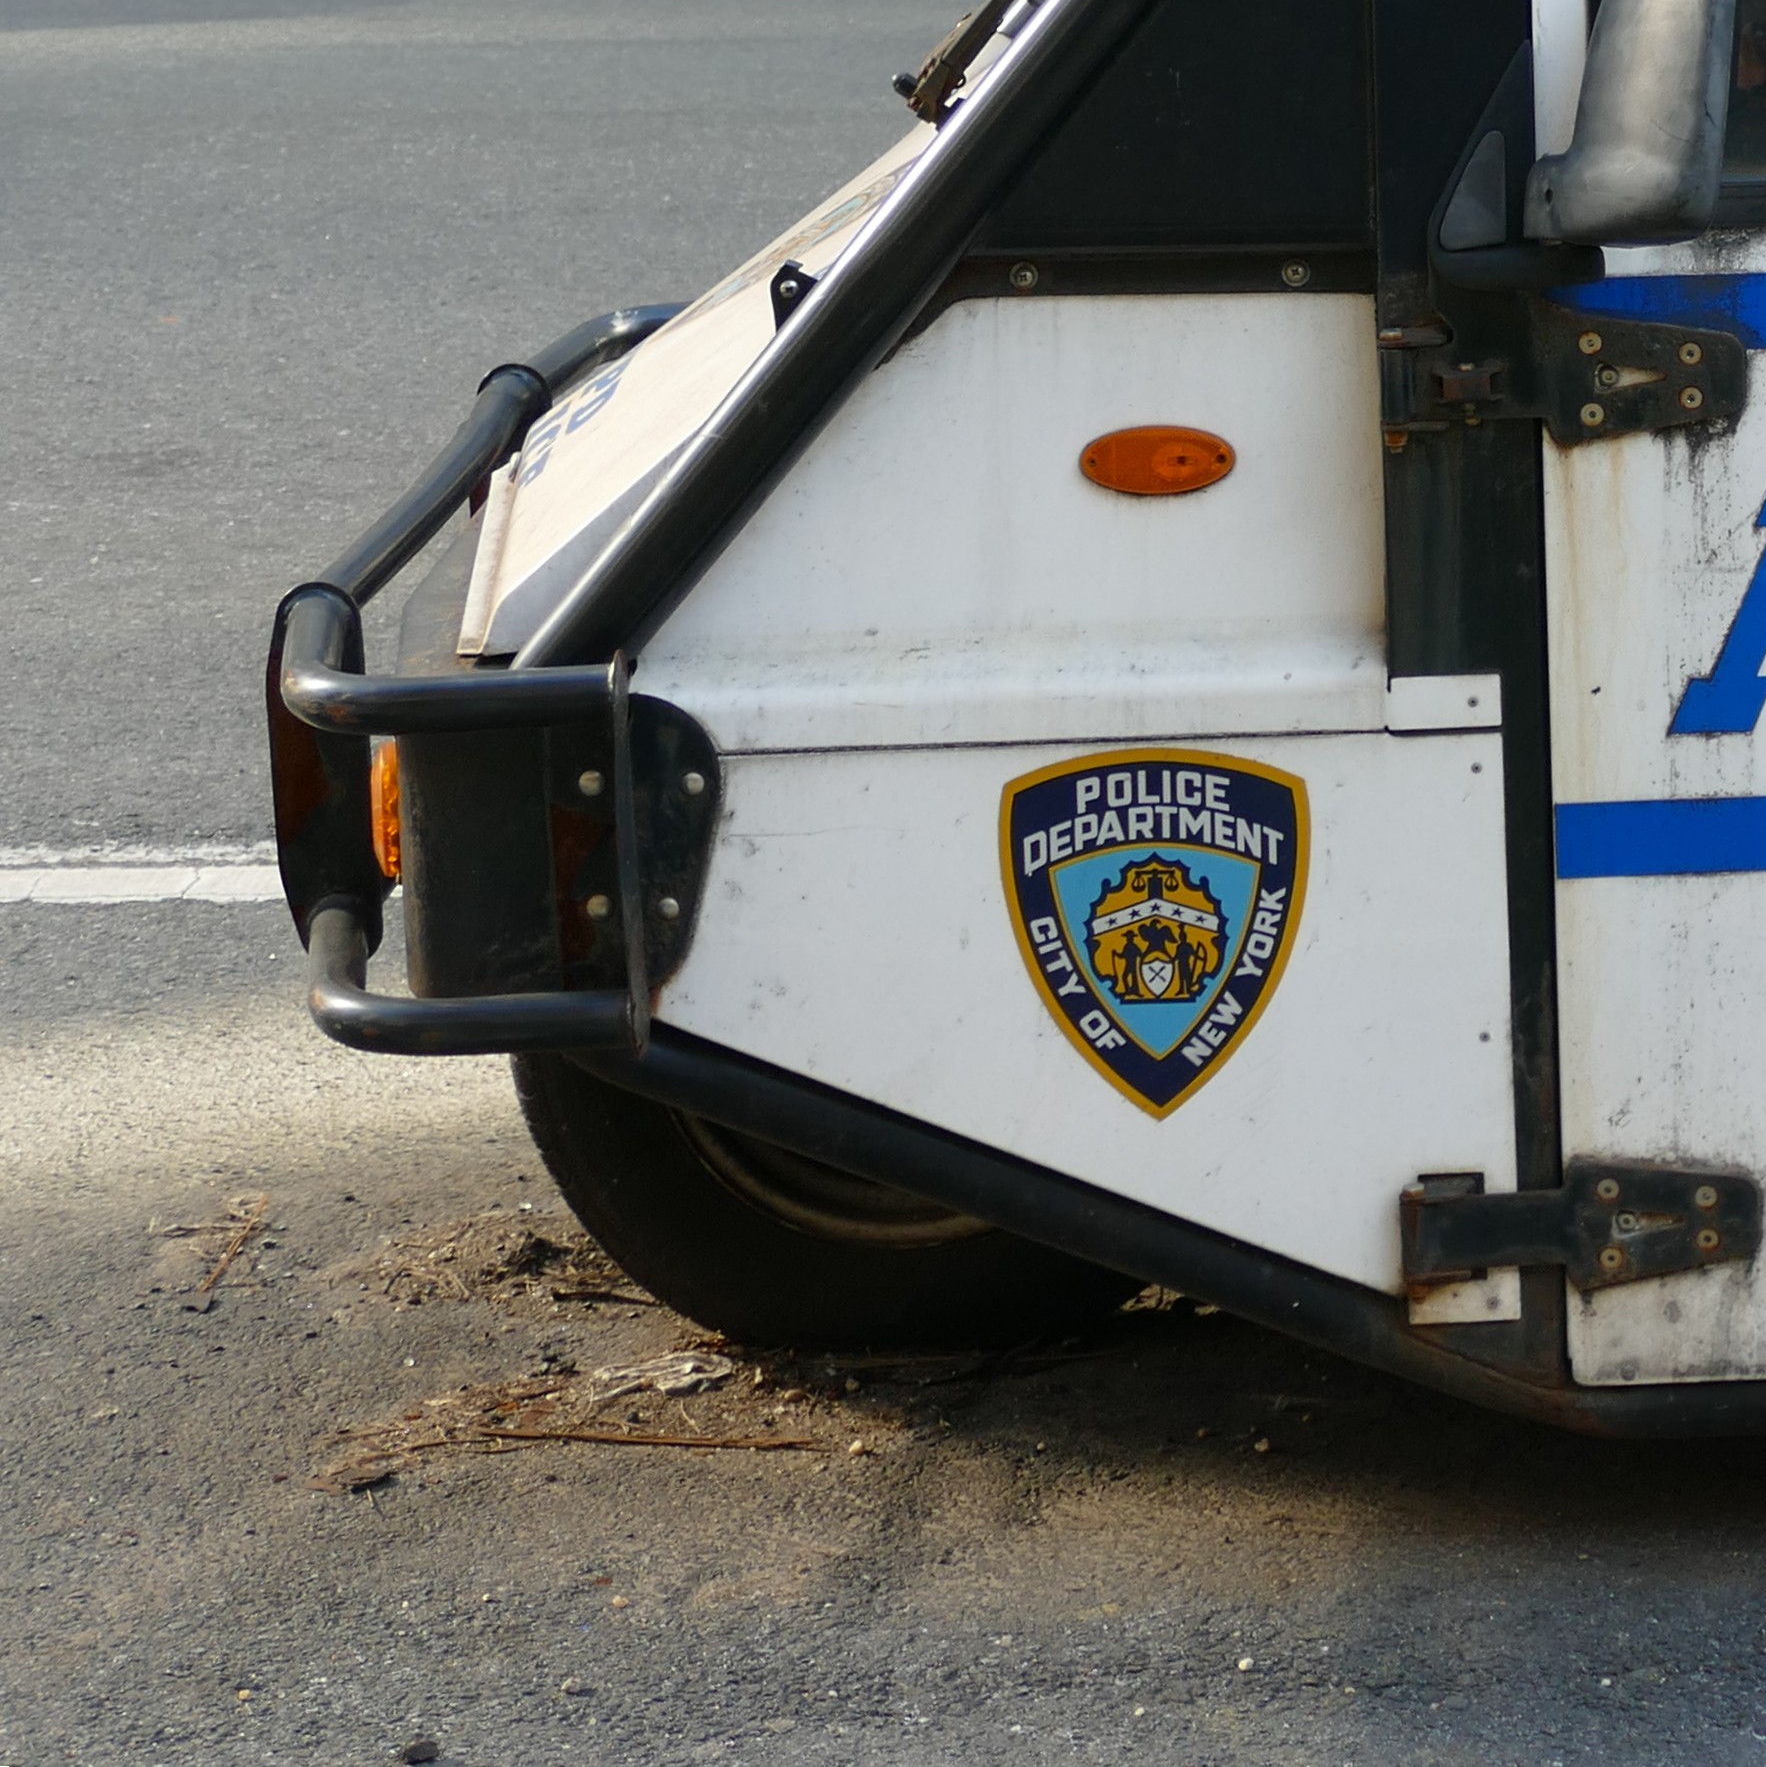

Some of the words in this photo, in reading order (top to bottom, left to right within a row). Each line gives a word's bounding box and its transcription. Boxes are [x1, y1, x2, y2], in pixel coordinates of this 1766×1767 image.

[1022, 804, 1285, 877] DEPARTMENT
[1075, 769, 1231, 814] POLICE
[1029, 914, 1087, 999] CITY
[1078, 1008, 1127, 1052] OF
[1180, 990, 1243, 1068] NEW
[1236, 886, 1288, 979] YORK
